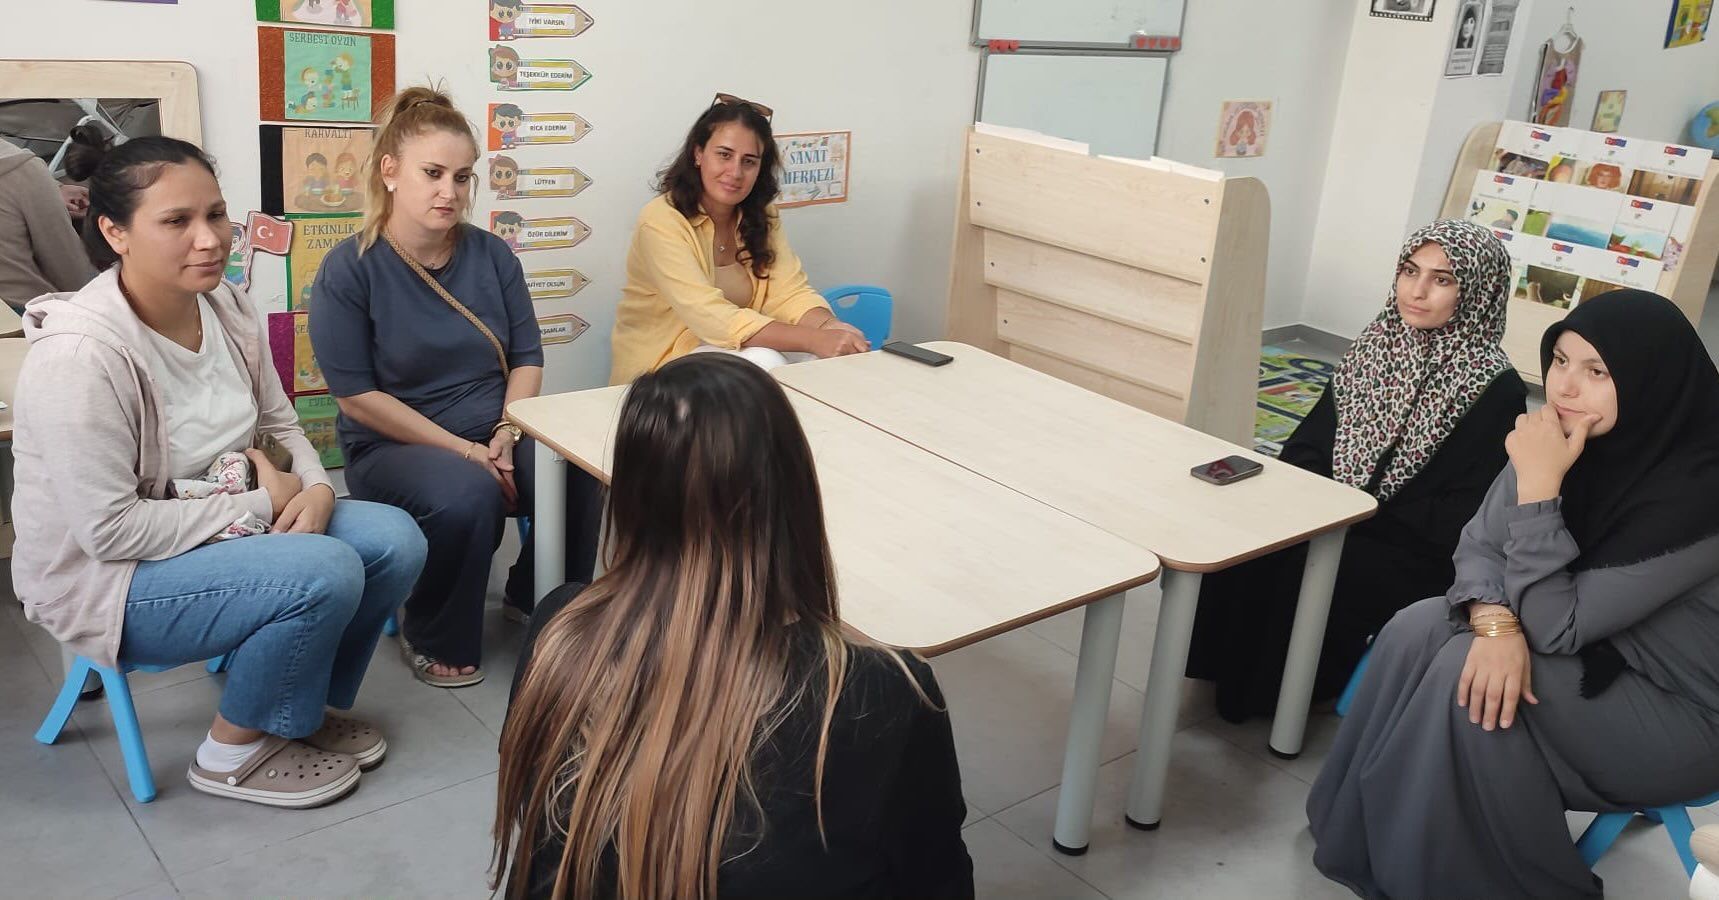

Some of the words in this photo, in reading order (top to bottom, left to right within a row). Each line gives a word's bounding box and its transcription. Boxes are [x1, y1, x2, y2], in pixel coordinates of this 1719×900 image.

[289, 32, 328, 44] SERBEST
[330, 35, 357, 47] OYUN
[790, 150, 828, 165] SANAT
[303, 221, 355, 236] ETKİNLİK
[306, 238, 343, 249] ZAMA
